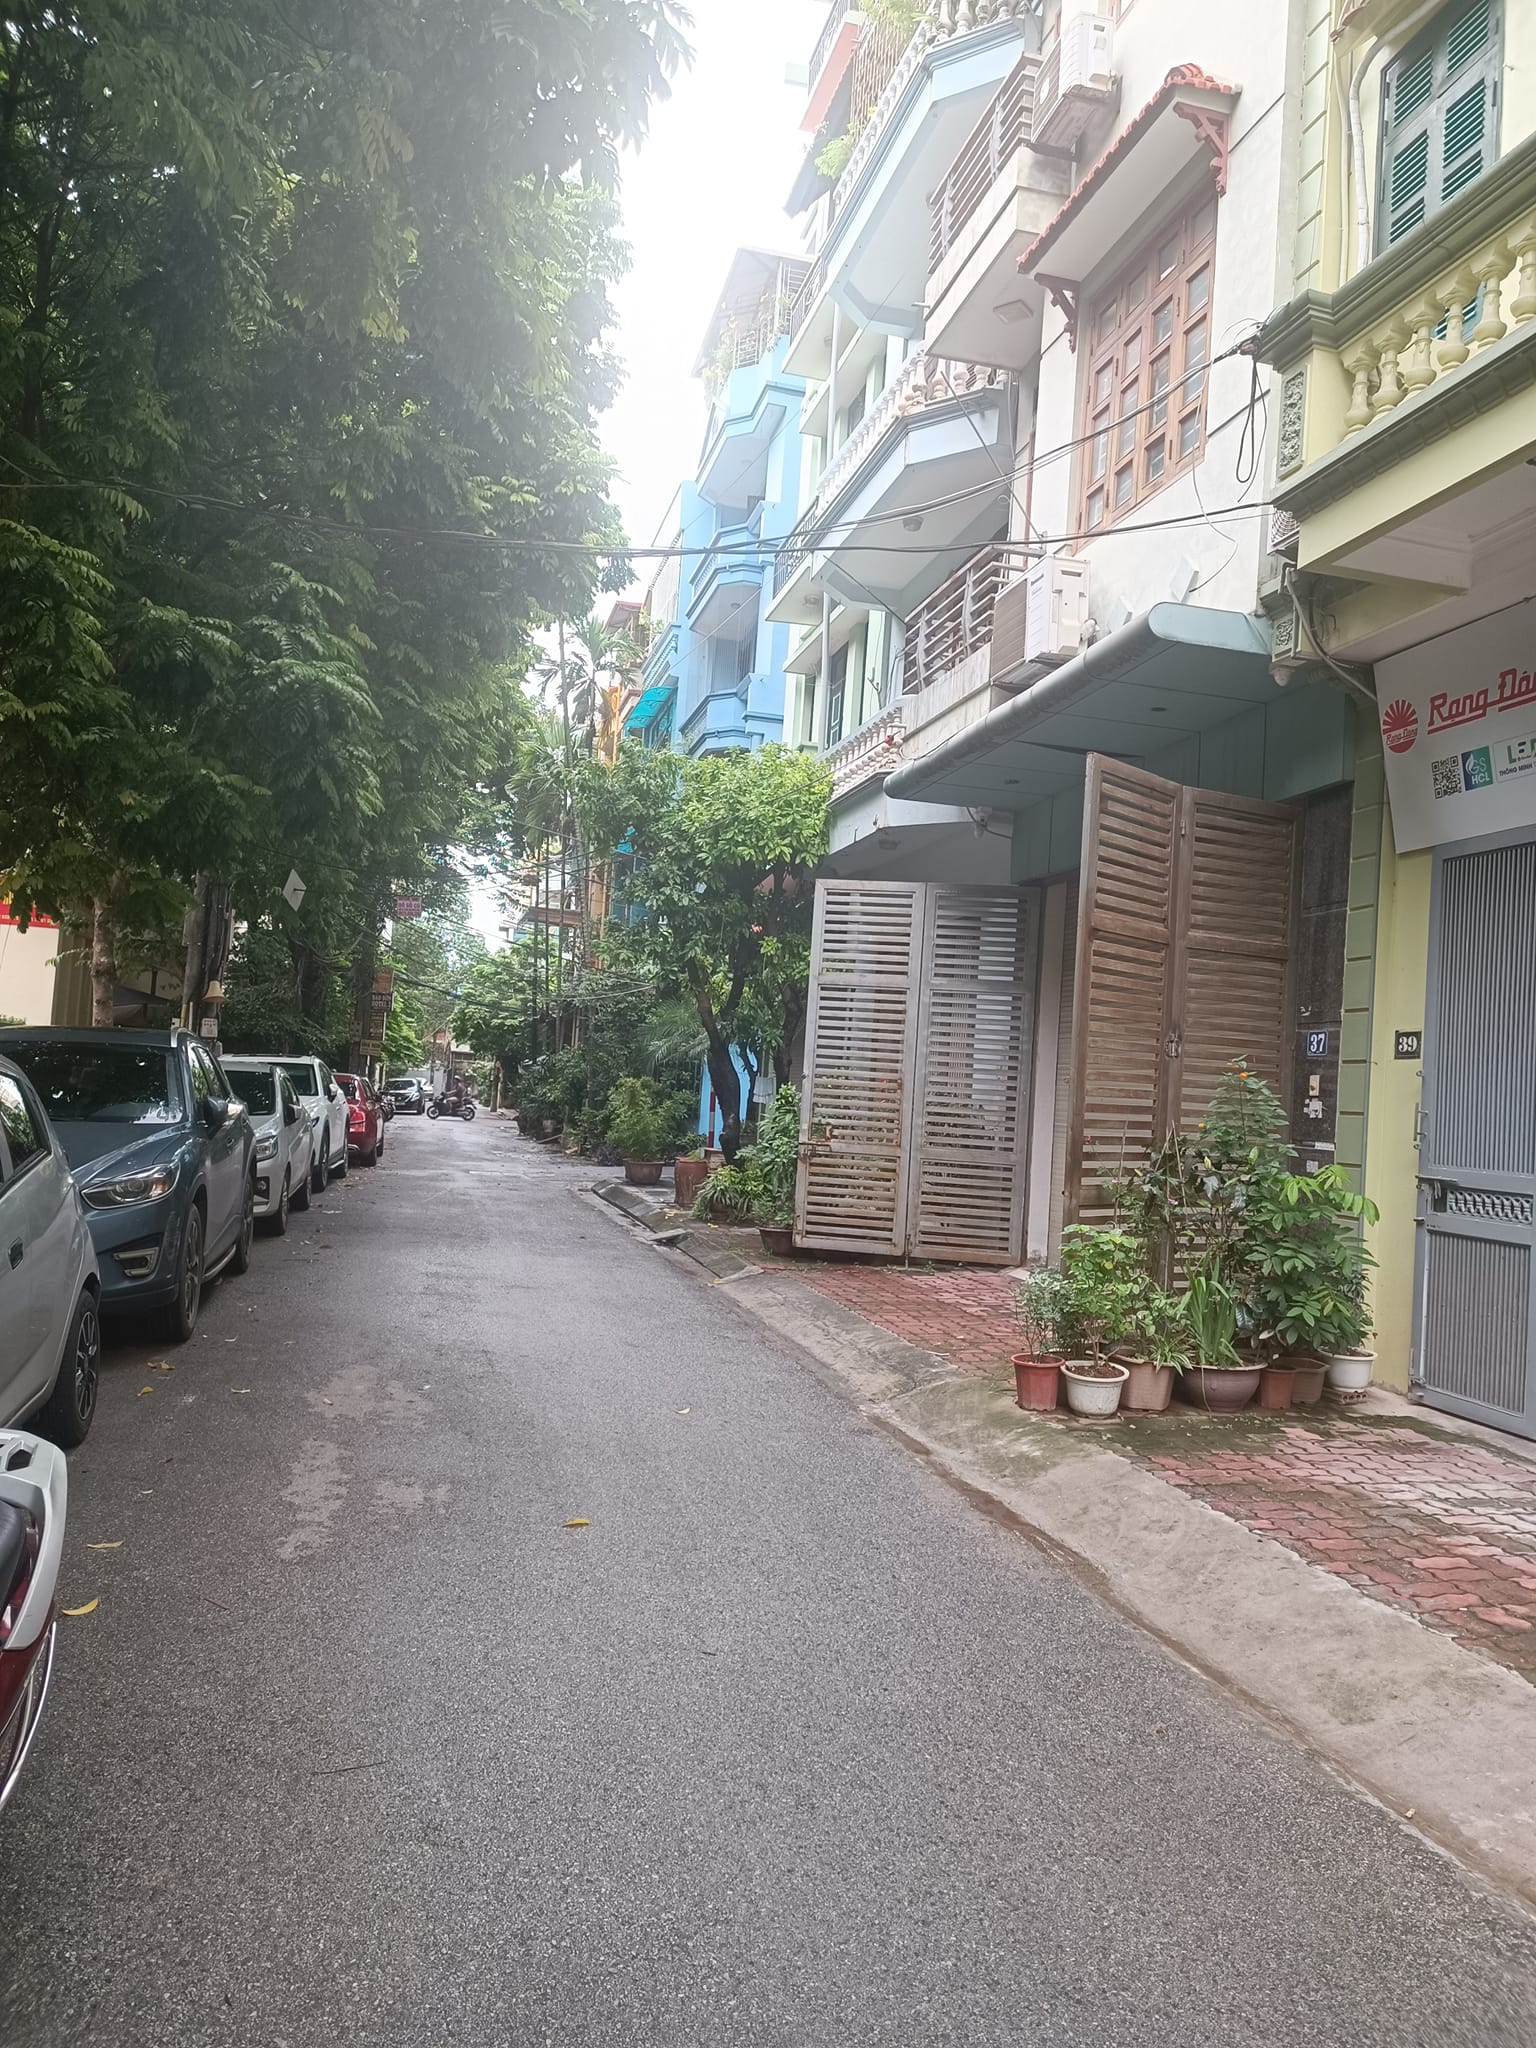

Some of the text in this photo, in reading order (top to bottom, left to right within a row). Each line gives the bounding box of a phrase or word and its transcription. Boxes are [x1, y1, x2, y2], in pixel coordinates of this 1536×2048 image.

[1471, 772, 1490, 785] HCL
[1310, 1033, 1325, 1052] 37
[1398, 1036, 1418, 1052] 39
